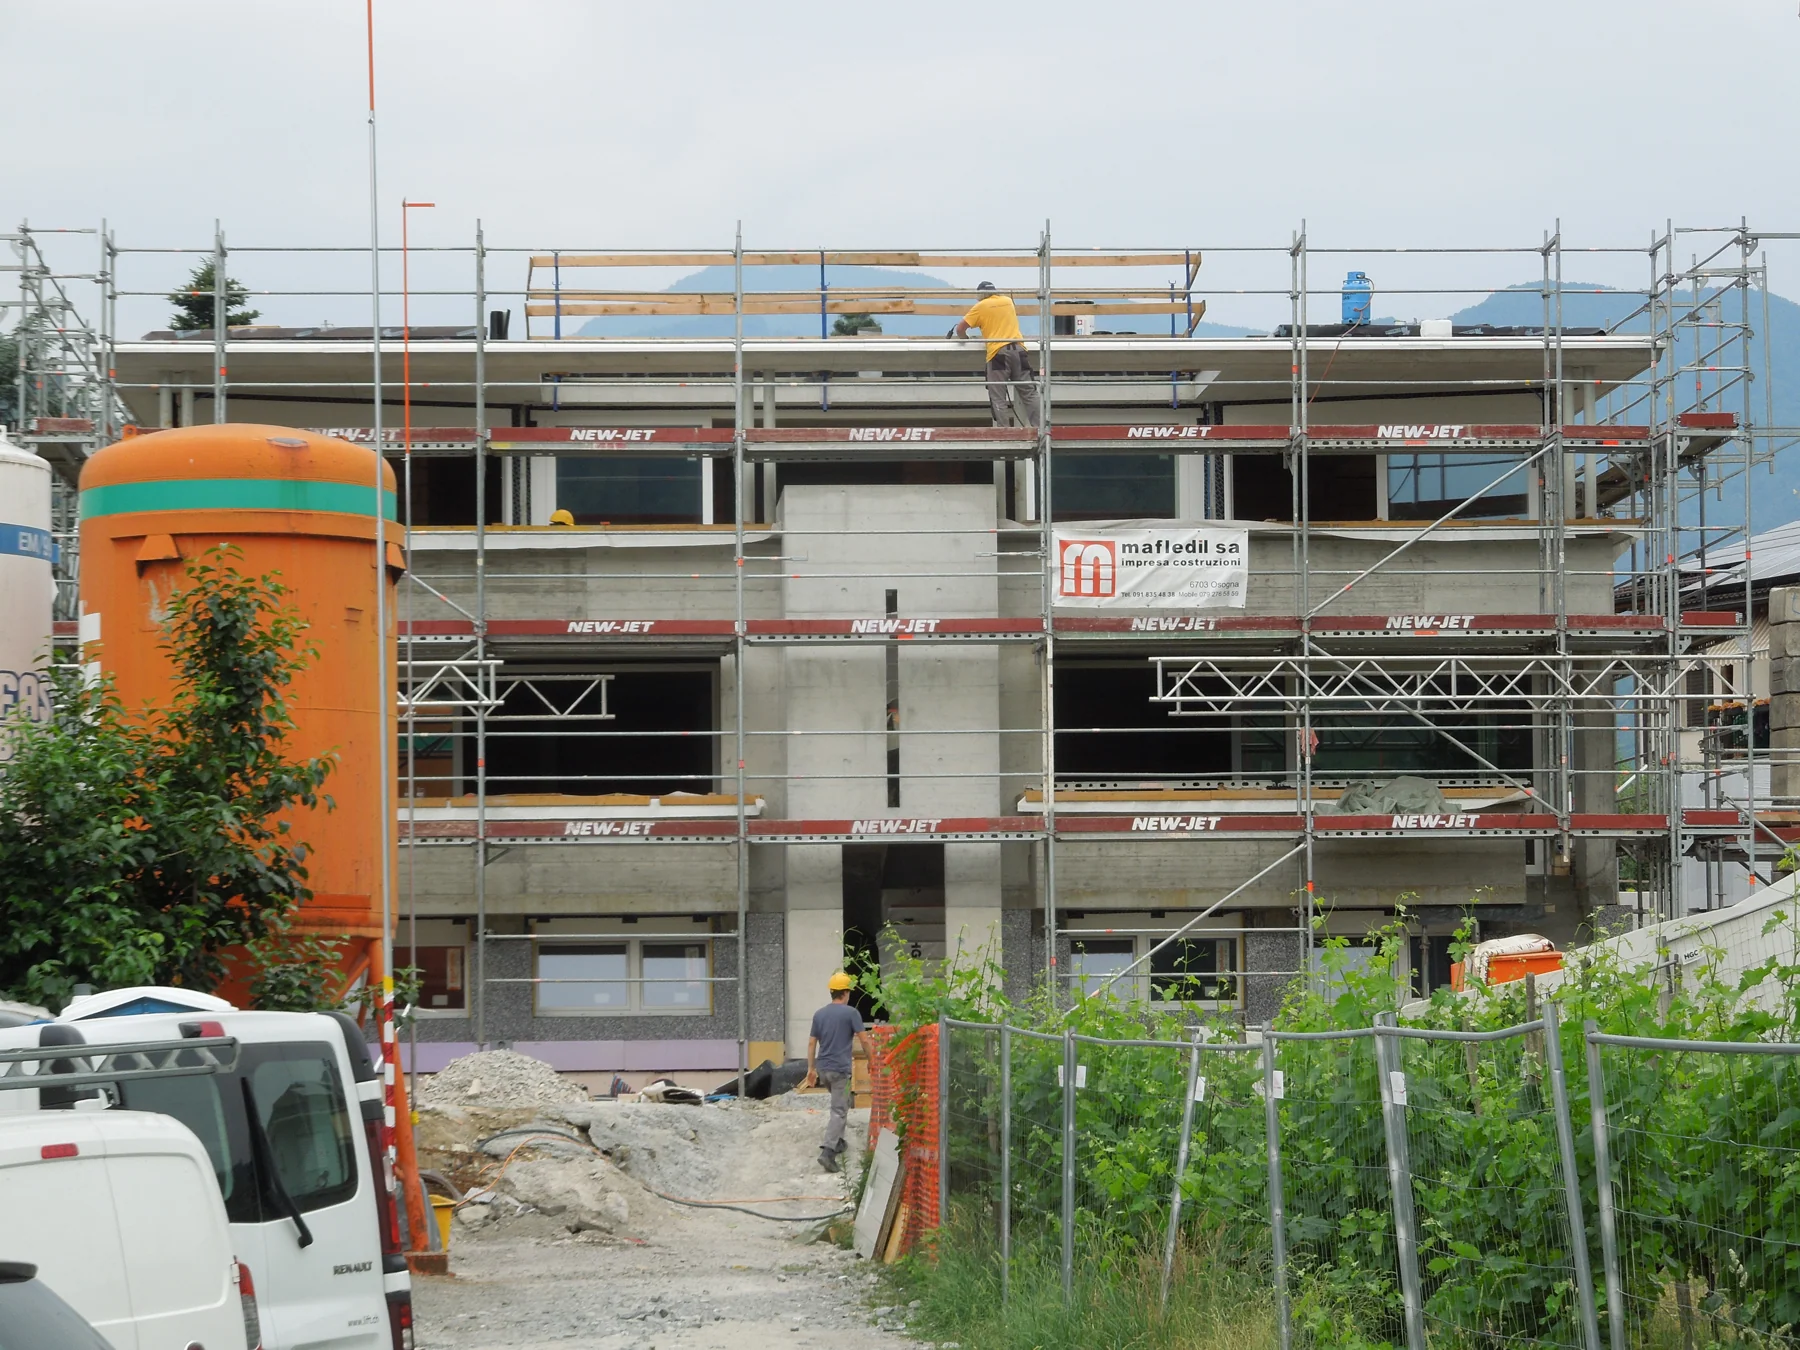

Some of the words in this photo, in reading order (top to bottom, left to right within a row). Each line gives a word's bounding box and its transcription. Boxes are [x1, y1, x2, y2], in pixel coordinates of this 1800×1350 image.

[569, 429, 656, 441] NEW-JET
[848, 428, 936, 441] NEW-JET
[1127, 426, 1211, 439] NEW-JET
[1376, 424, 1464, 438] NEW-JET
[1121, 540, 1208, 554] mafledil
[1215, 543, 1240, 554] sa
[1121, 558, 1169, 568] impresa
[1173, 558, 1241, 567] costruzioni
[1189, 581, 1209, 589] 6703
[1211, 580, 1239, 590] Osogna
[566, 621, 655, 634] NEW-JET
[851, 619, 941, 633] NEW-JET
[1386, 614, 1475, 629] NEW-JET
[564, 820, 655, 836] NEW-JET
[851, 819, 942, 834] NEW-JET
[1131, 815, 1219, 831] NEW-JET
[1390, 814, 1480, 829] NEW-JET
[1683, 949, 1699, 960] HGC
[333, 1261, 372, 1275] RENAULT
